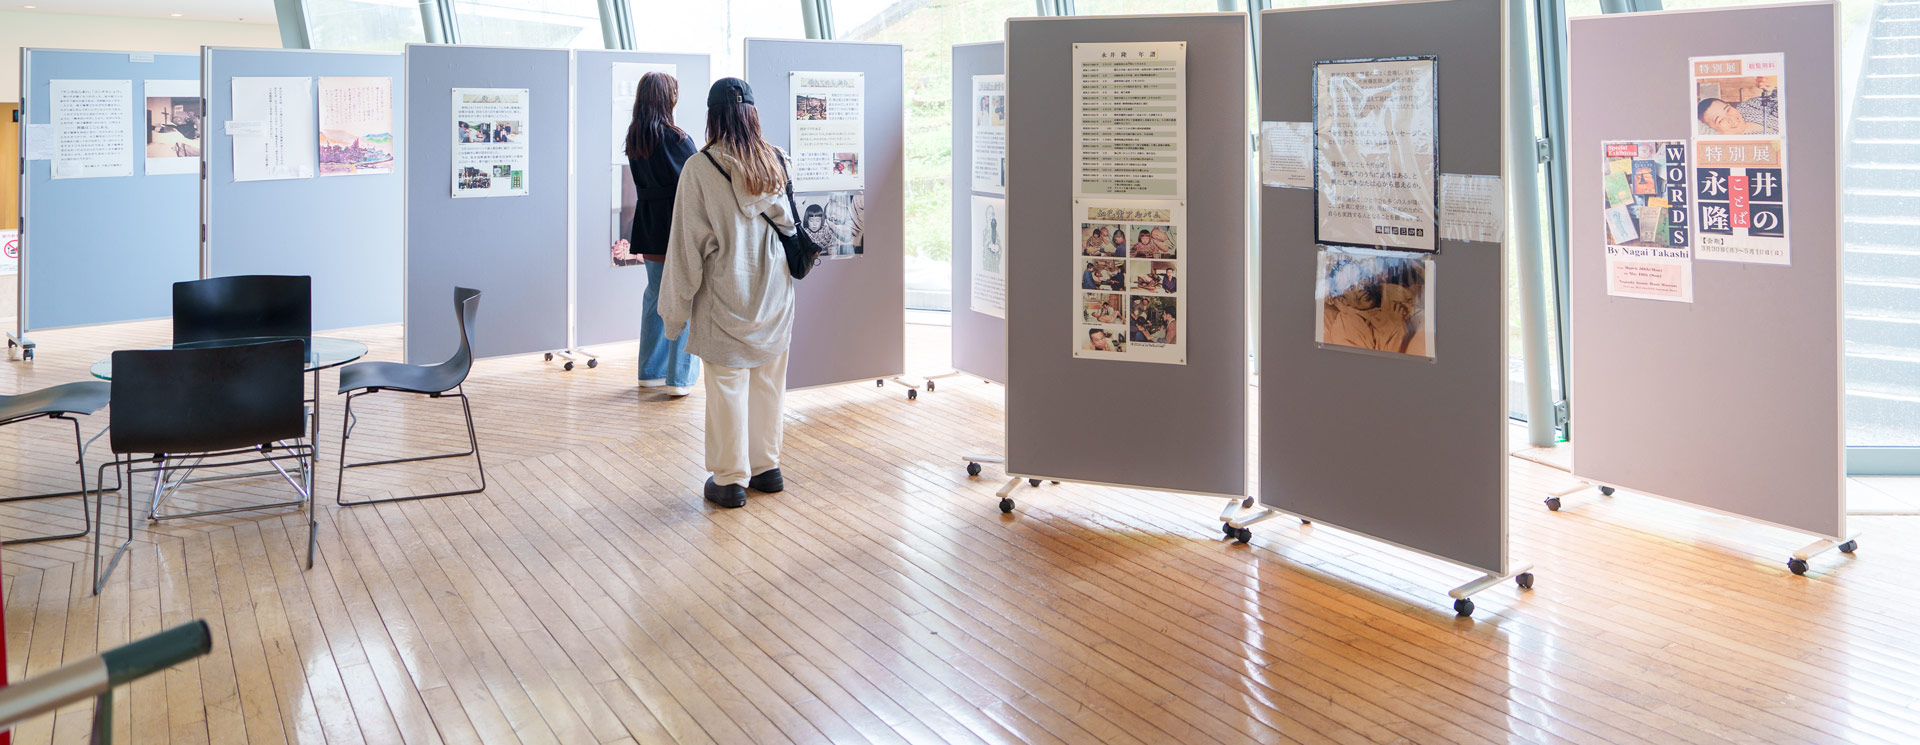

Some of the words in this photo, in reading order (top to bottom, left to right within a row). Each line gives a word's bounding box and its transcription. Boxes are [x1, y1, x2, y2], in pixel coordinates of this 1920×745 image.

[1699, 63, 1736, 74] 特別展
[1705, 145, 1770, 162] 特別展
[1666, 147, 1685, 244] WORDS
[1733, 178, 1748, 225] ことば
[1608, 246, 1619, 256] By
[1622, 247, 1648, 257] Nagai
[1651, 249, 1689, 258] Takashi
